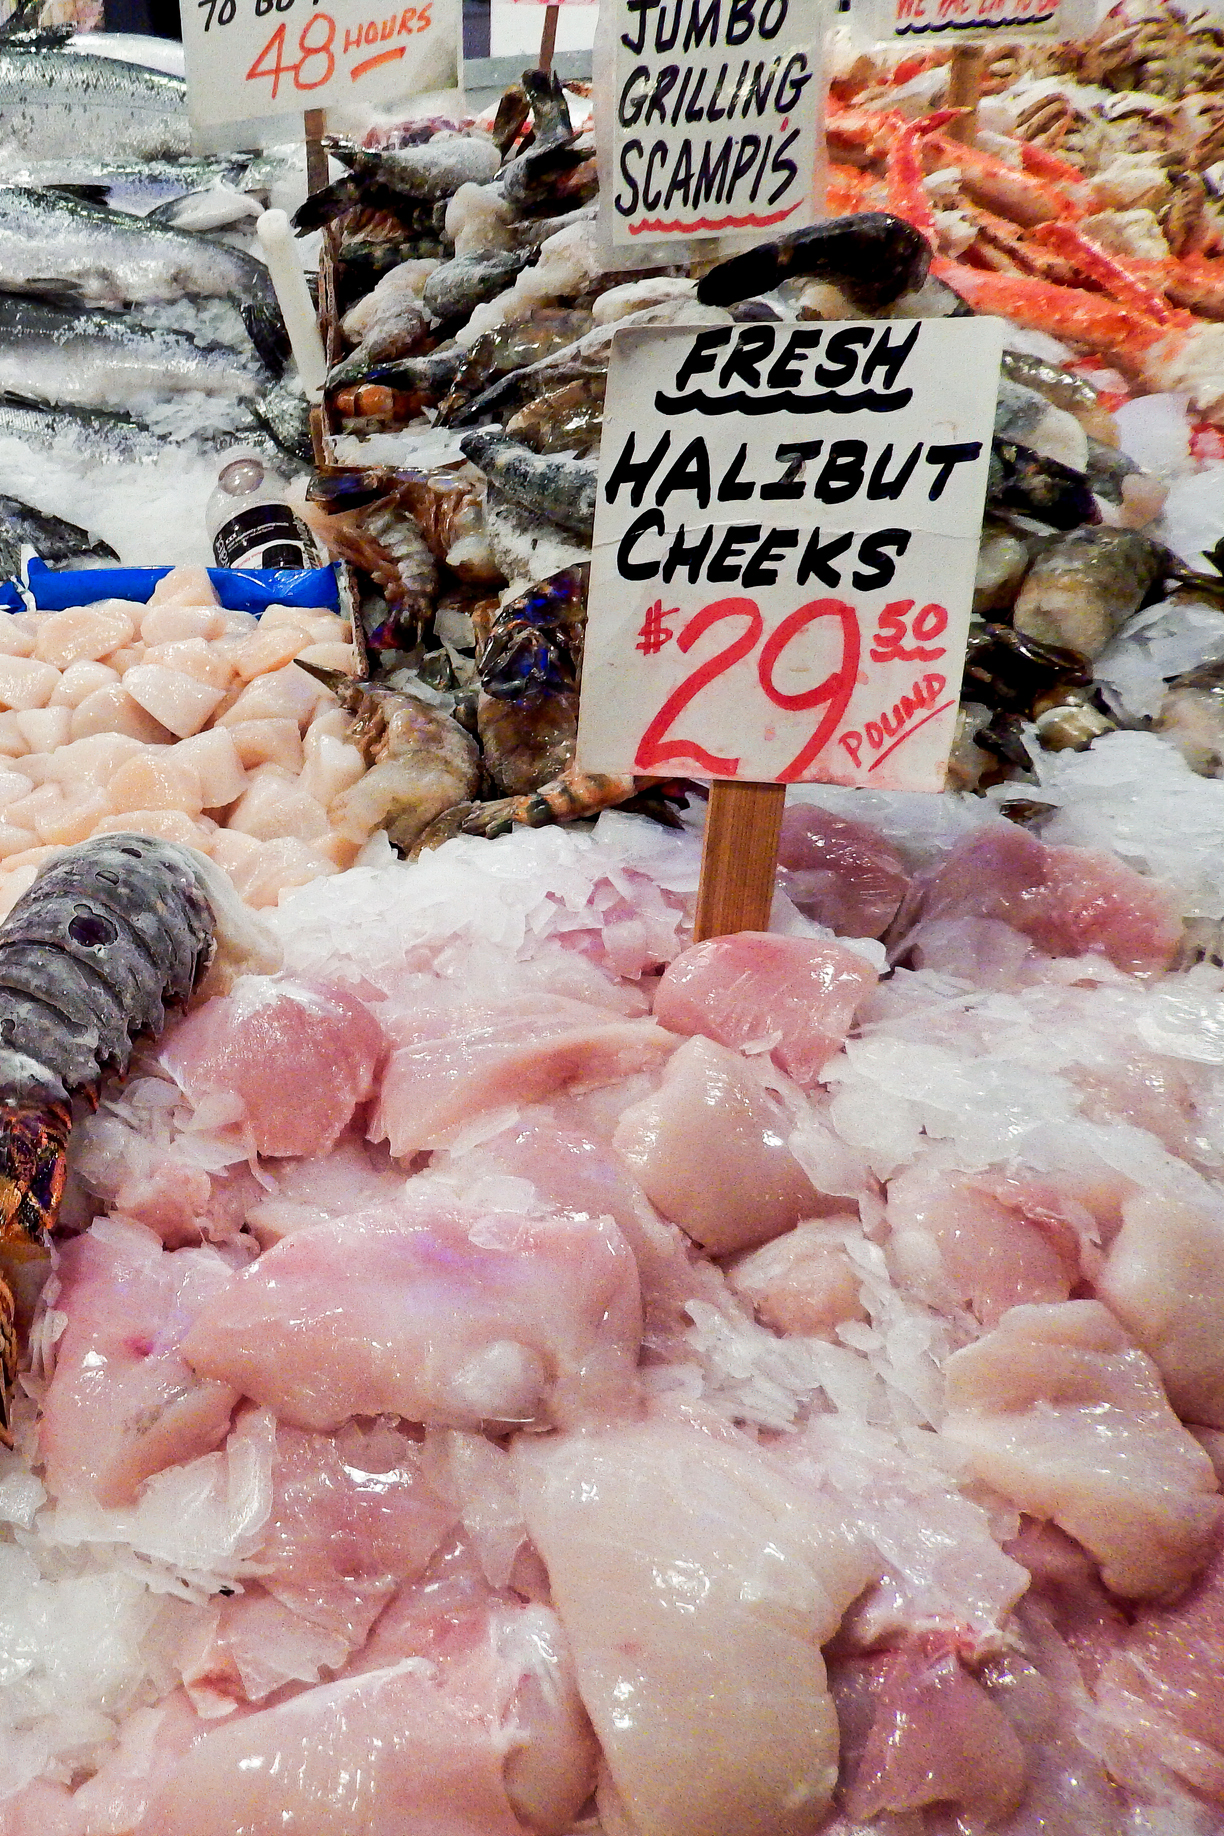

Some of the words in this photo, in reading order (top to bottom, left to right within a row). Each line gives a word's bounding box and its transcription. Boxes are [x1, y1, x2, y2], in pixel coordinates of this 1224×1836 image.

[246, 12, 336, 100] 48
[343, 3, 434, 54] HOURS
[620, 0, 789, 55] JUMBO
[618, 52, 813, 128] GRILLING
[675, 321, 922, 392] FRESH
[604, 429, 983, 509] HALIBUT
[616, 508, 912, 592] CHEEKS
[873, 598, 948, 648] 50
[837, 673, 947, 768] POUND
